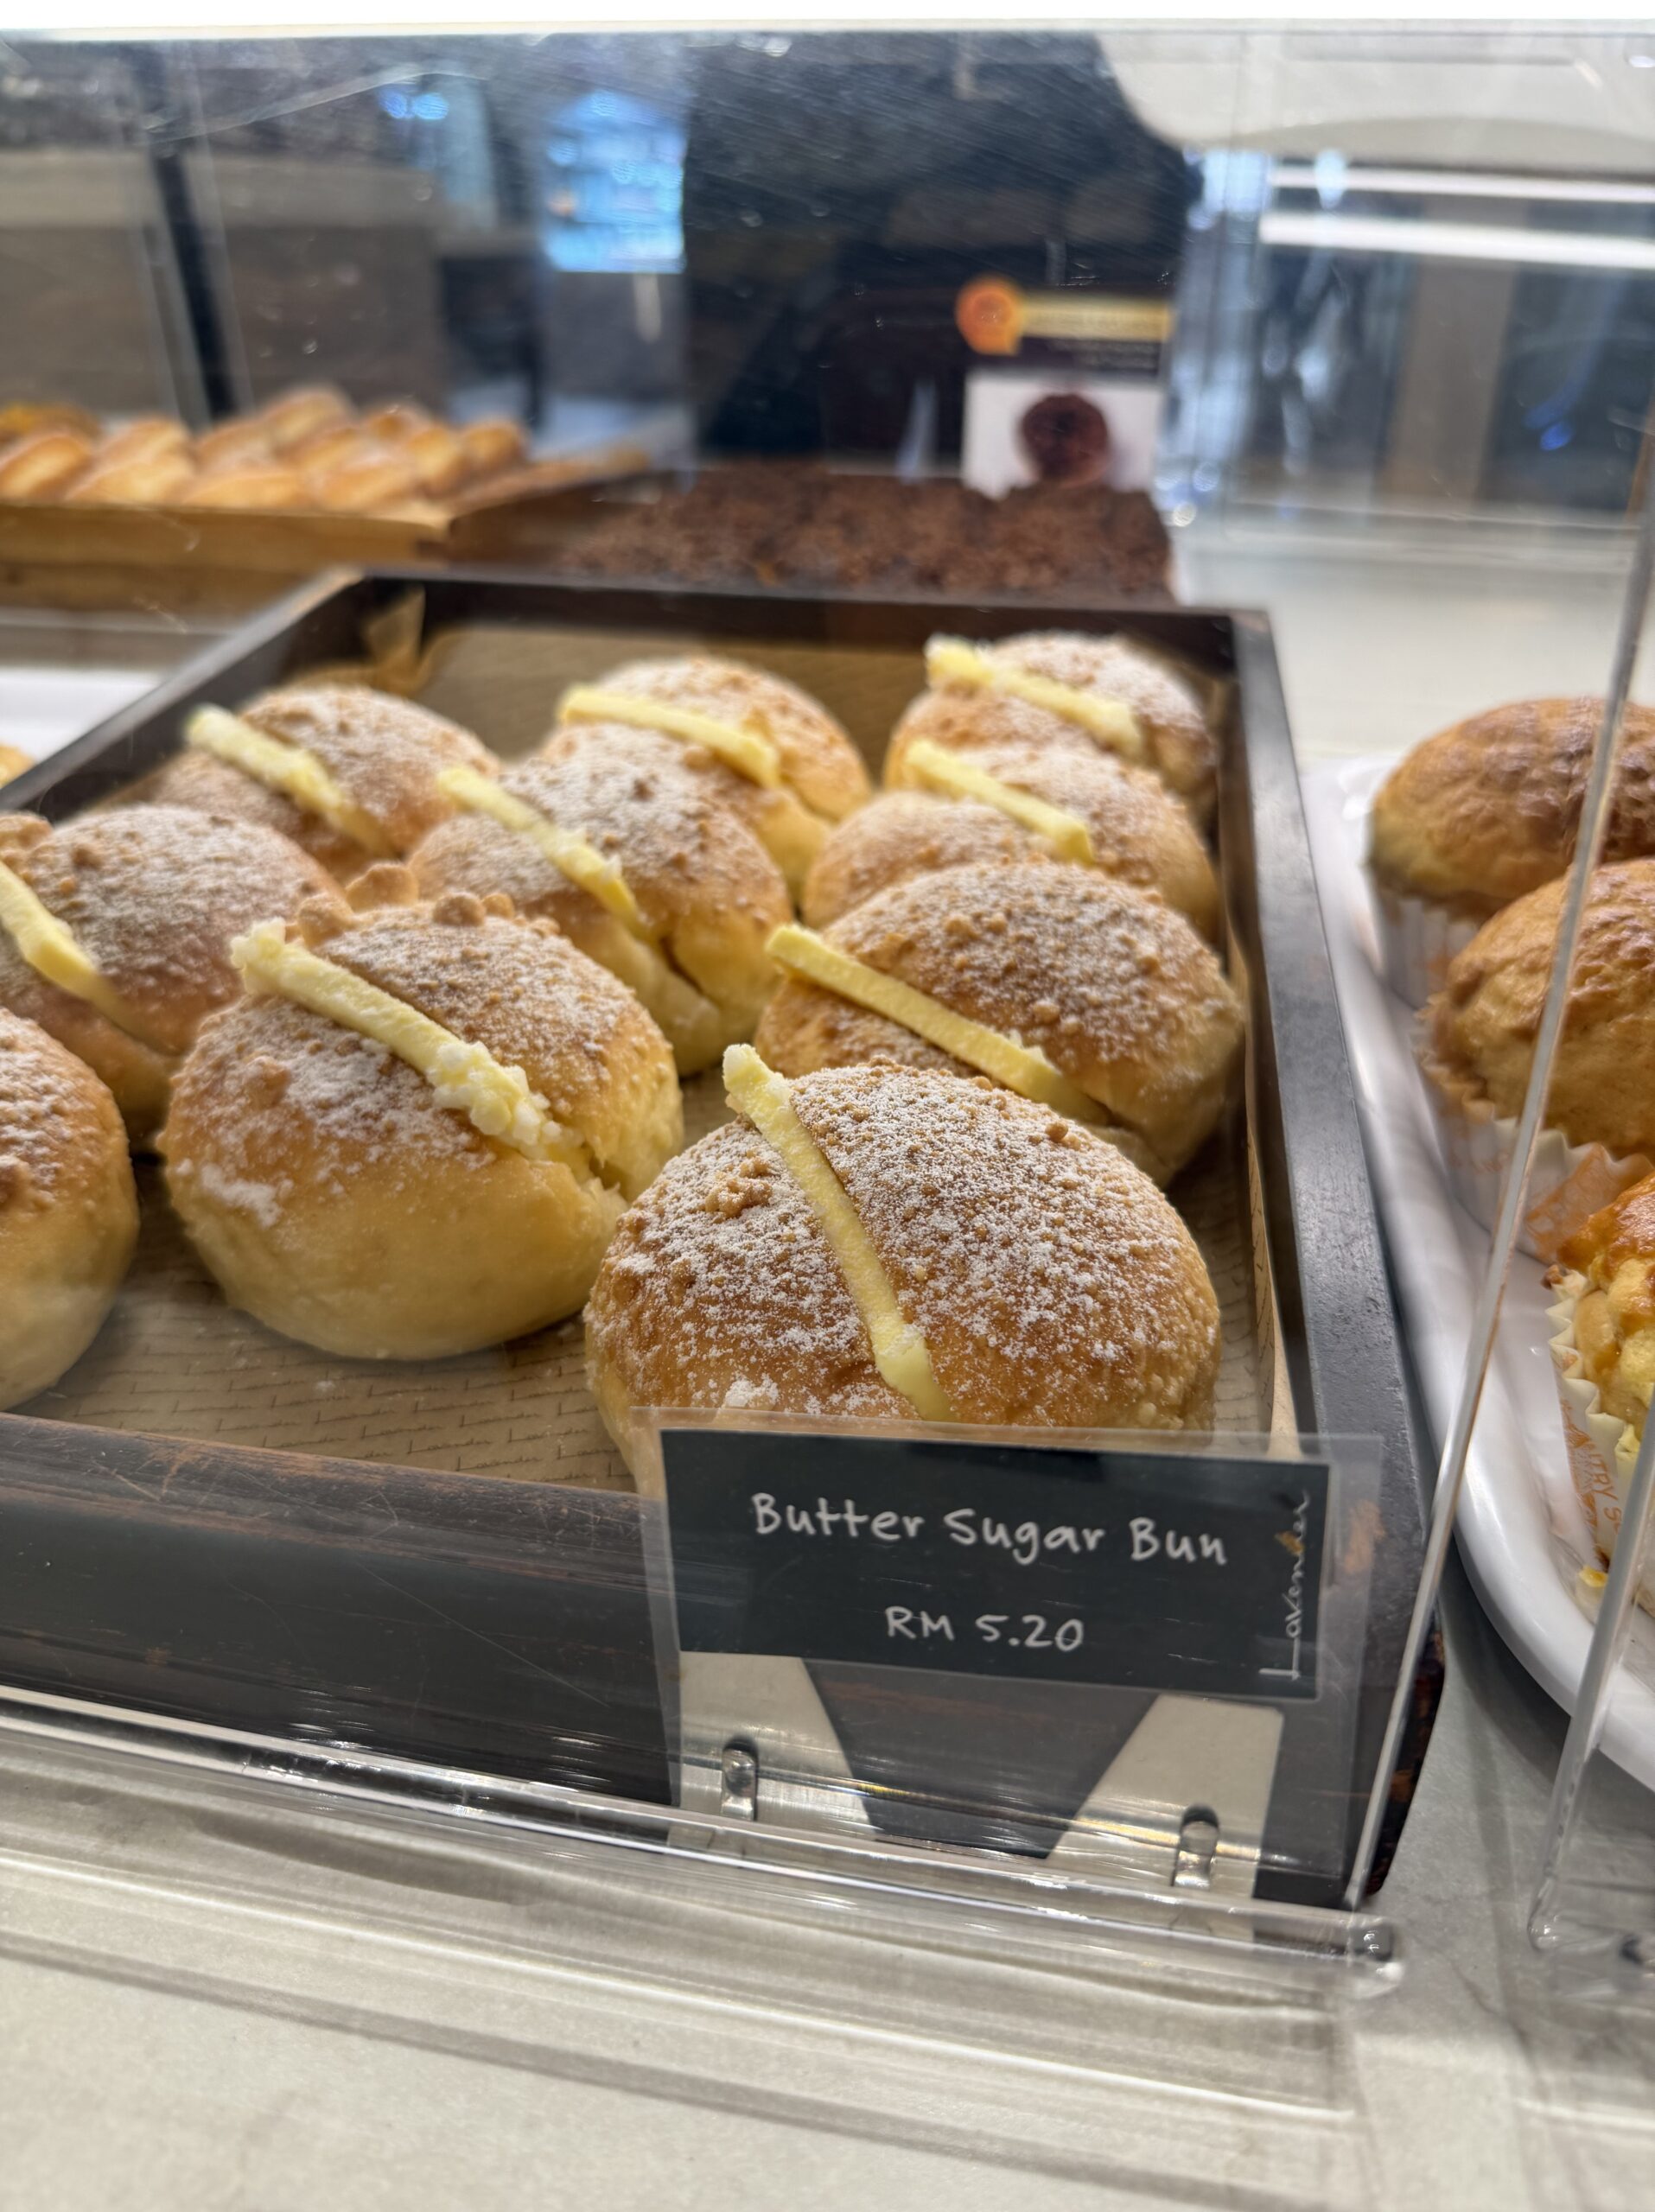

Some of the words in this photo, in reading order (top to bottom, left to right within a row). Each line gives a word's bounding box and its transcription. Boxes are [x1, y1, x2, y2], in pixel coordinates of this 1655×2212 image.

[752, 1492, 925, 1540] Butter
[944, 1508, 1105, 1565] Sugar
[1129, 1516, 1227, 1566] Bun
[885, 1605, 955, 1641] RM
[976, 1614, 1085, 1652] 5.20
